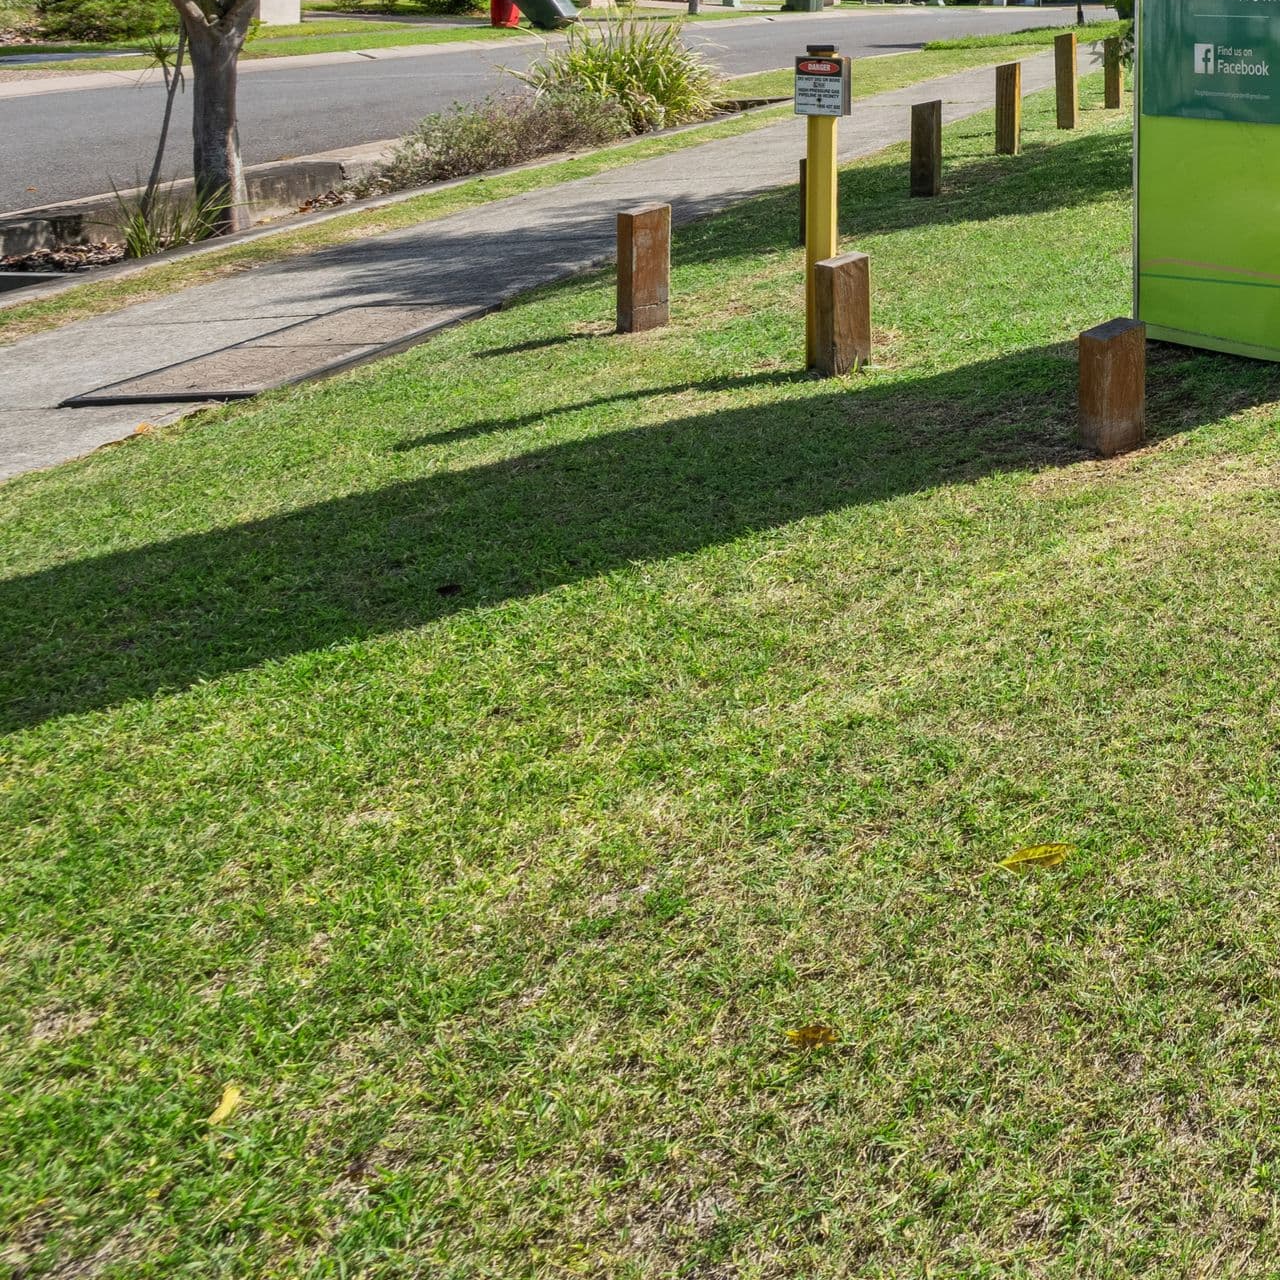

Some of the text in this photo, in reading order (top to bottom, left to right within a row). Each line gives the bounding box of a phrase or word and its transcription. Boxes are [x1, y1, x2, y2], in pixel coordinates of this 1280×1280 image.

[1217, 45, 1233, 57] Find
[1234, 48, 1241, 57] us
[1243, 48, 1253, 57] on
[808, 63, 831, 72] DANGER
[1217, 59, 1269, 76] Facebook
